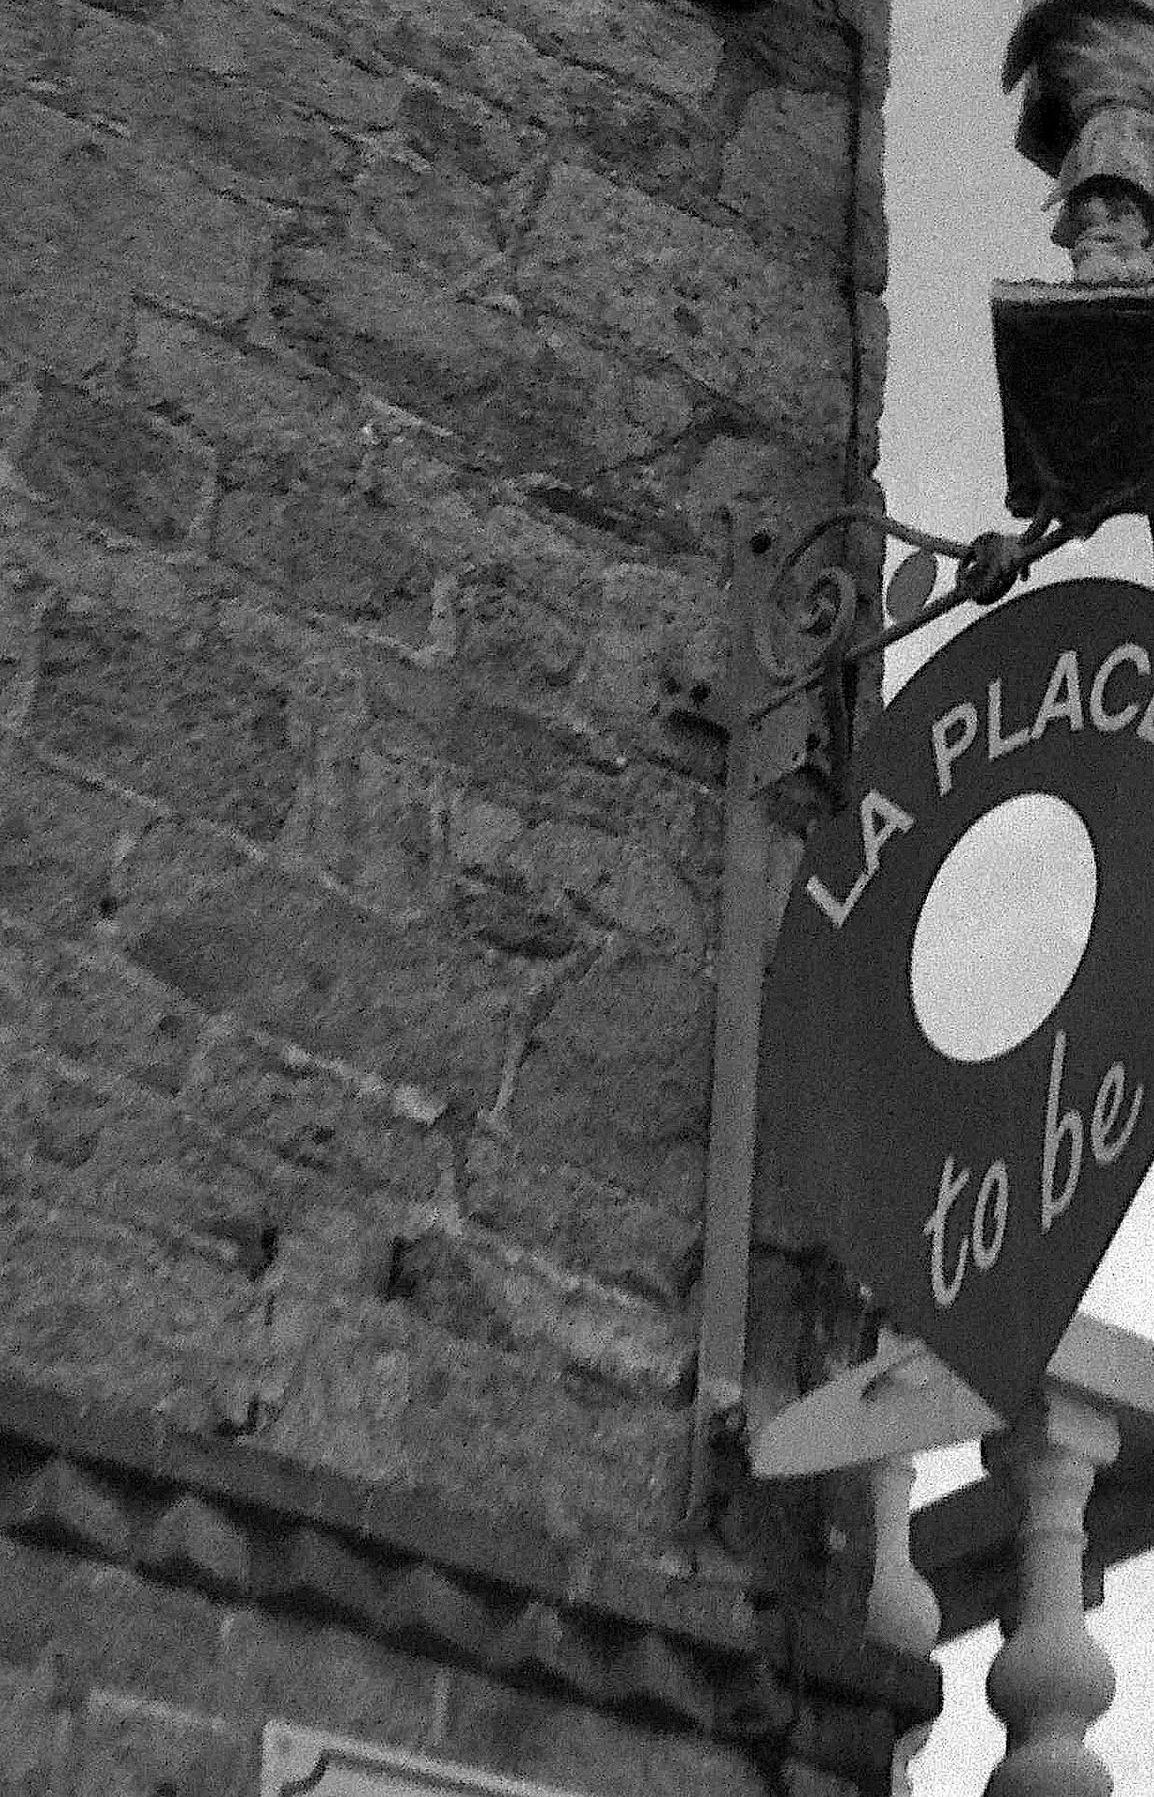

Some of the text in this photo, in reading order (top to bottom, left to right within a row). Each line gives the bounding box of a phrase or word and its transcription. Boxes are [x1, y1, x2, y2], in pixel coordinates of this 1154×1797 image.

[806, 790, 914, 928] LA
[923, 1029, 1144, 1307] to be
